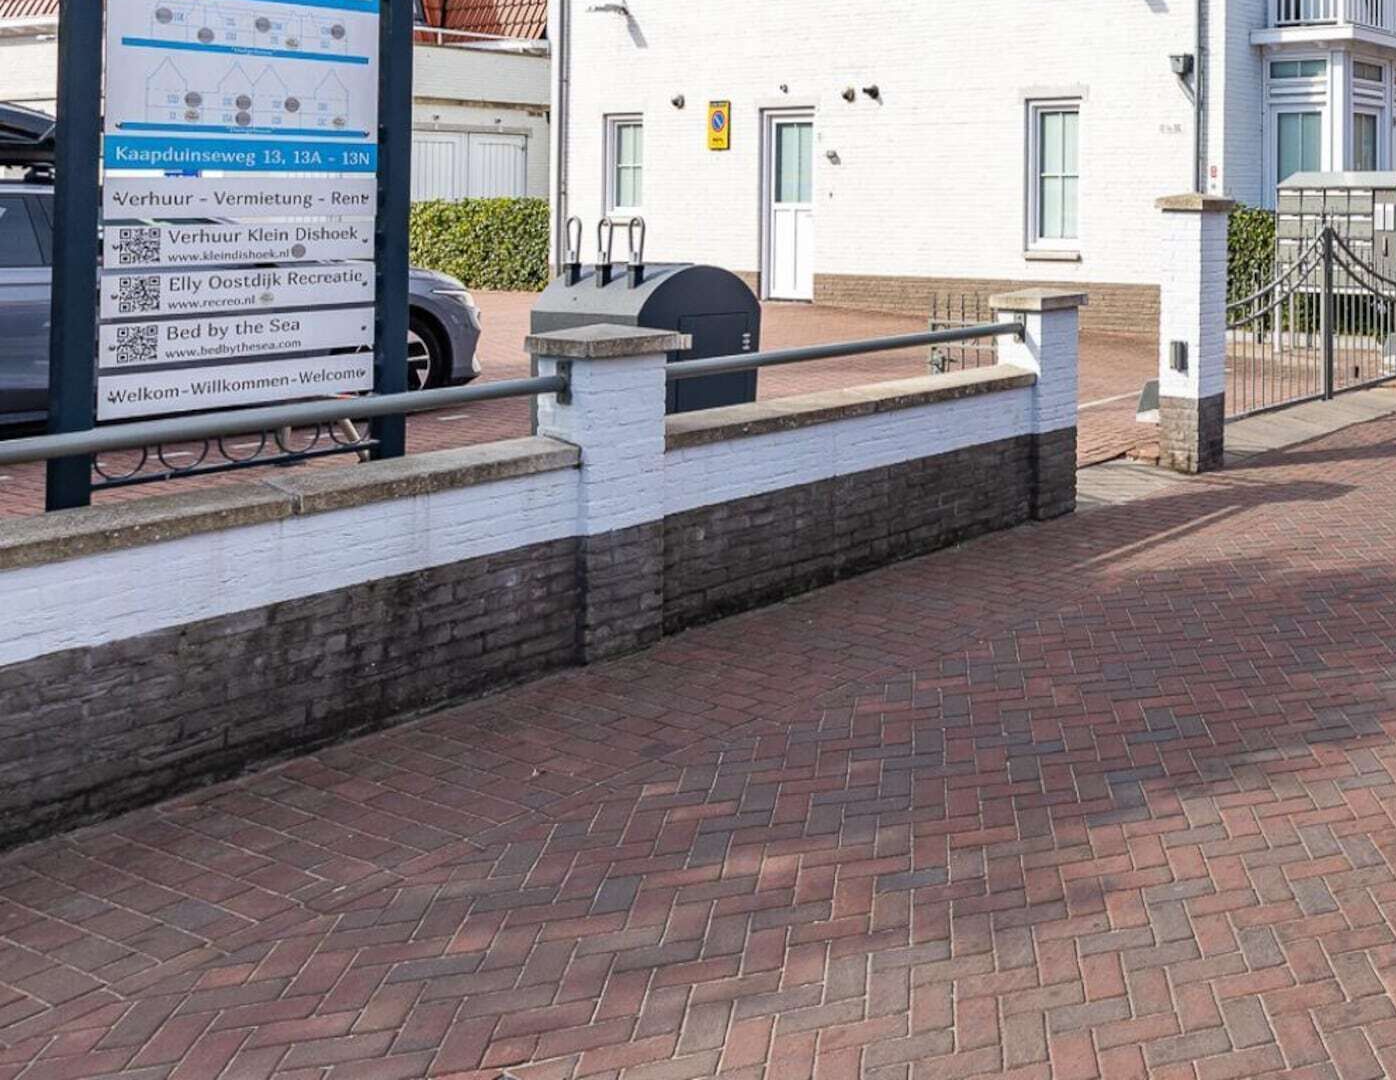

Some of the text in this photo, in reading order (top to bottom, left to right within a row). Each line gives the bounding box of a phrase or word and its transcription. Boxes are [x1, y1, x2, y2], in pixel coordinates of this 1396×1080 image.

[115, 146, 255, 167] Kaapduinseweg
[263, 150, 286, 166] 13,
[293, 150, 321, 165] 13A
[342, 152, 370, 166] 13N
[115, 191, 194, 206] Verhuur
[214, 190, 313, 209] Vermietung
[168, 226, 358, 244] Verhuur Klein Dishoek
[168, 248, 290, 263] www.kleindishoek.nl
[169, 271, 363, 294] Elly Oostdijk Recreatie
[168, 296, 256, 310] www.recreo.nl
[167, 318, 301, 341] Bed by the Sea
[165, 339, 302, 360] www.bedbythesea.com
